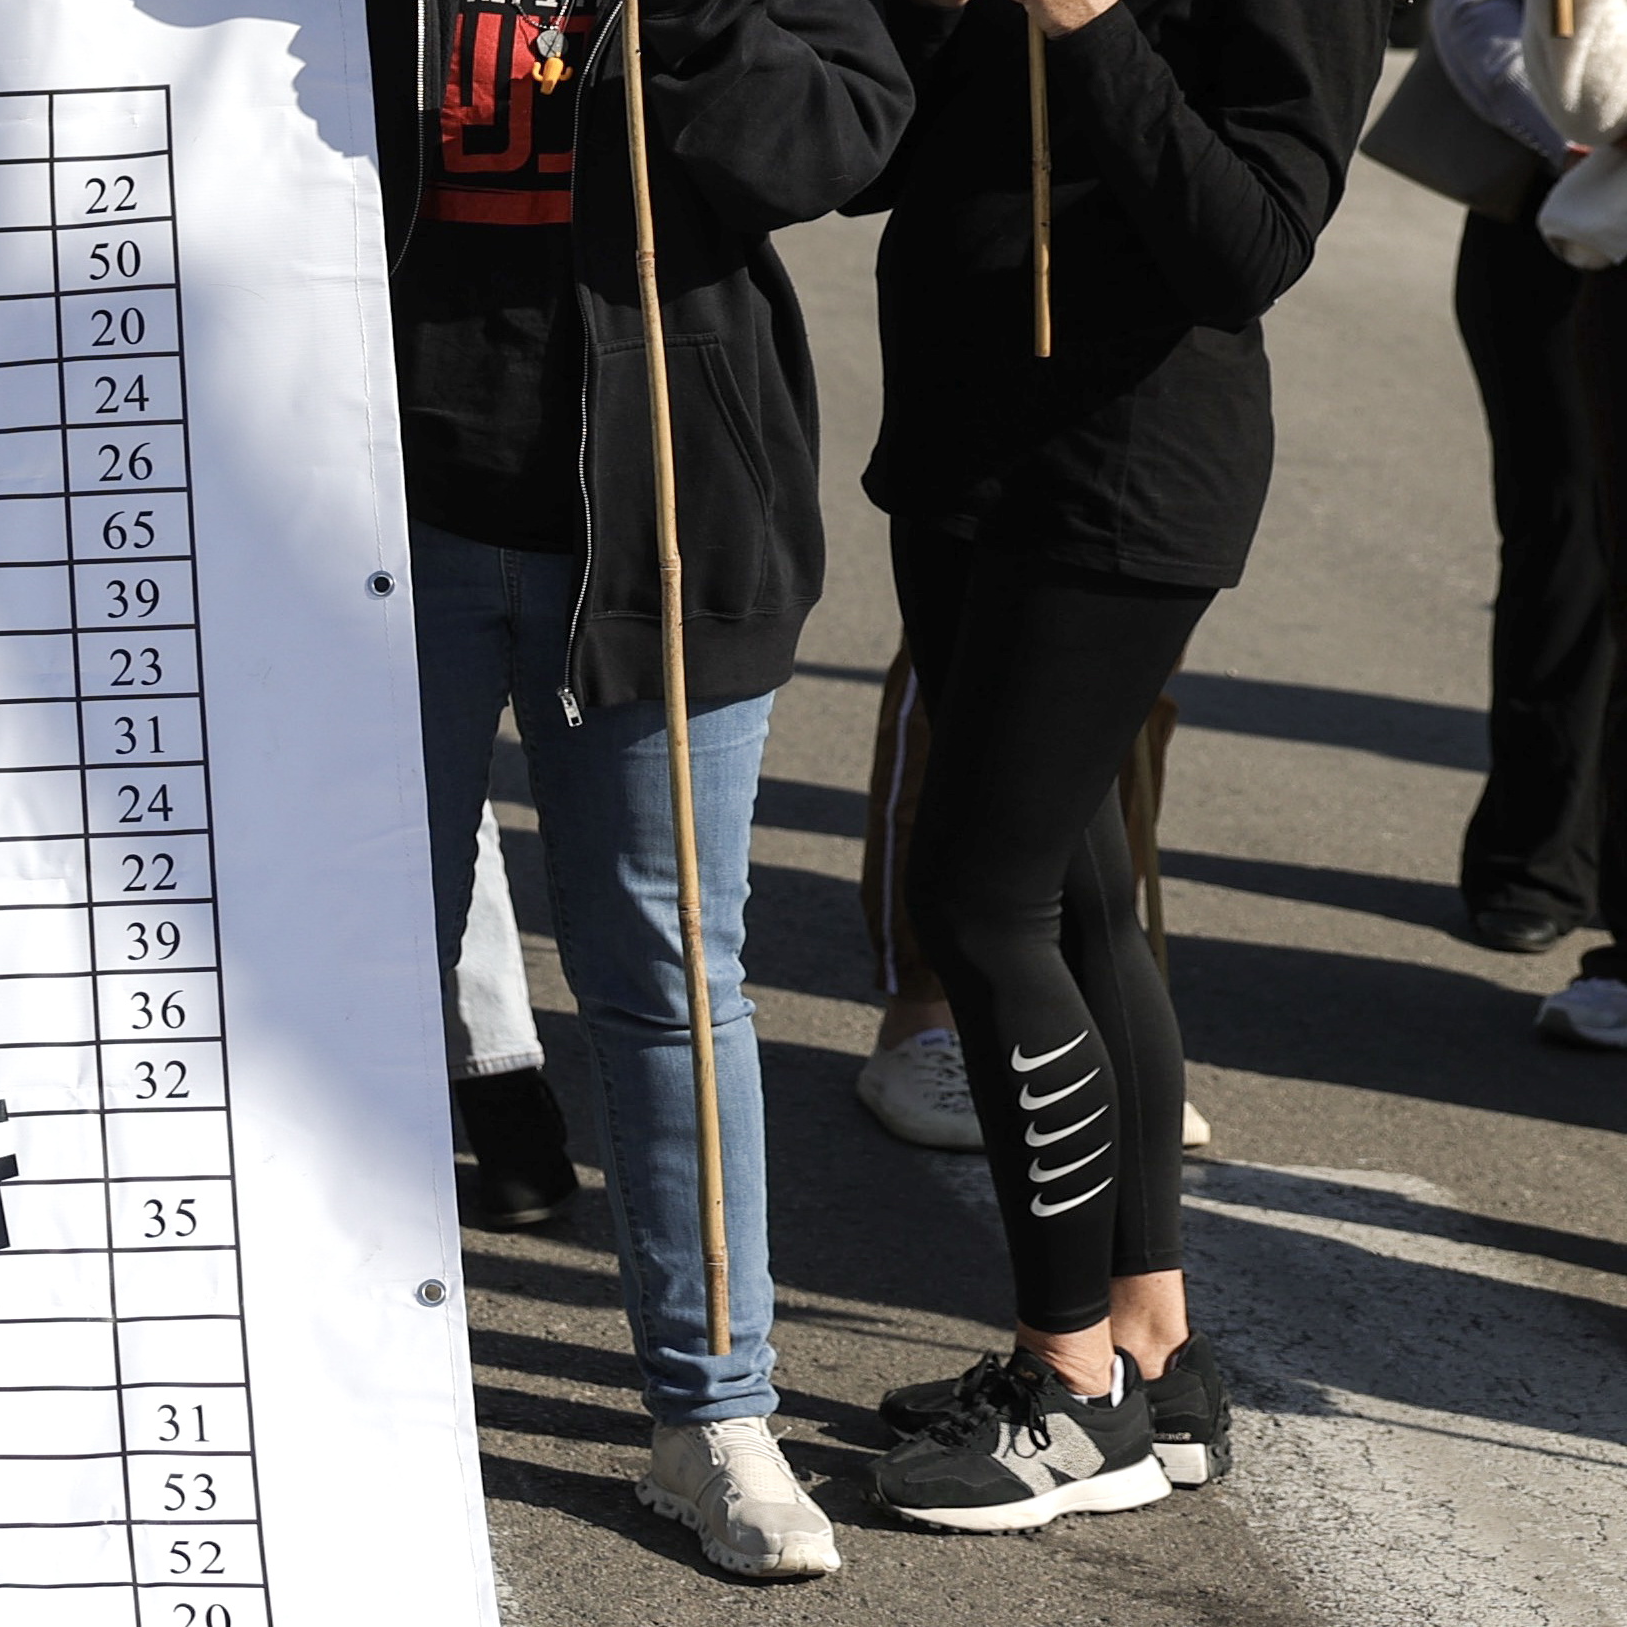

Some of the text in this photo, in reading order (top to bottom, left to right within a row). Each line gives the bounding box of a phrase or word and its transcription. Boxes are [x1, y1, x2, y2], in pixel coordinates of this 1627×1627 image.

[85, 175, 138, 215] 22
[102, 512, 155, 550] 65
[162, 1473, 218, 1511] 53
